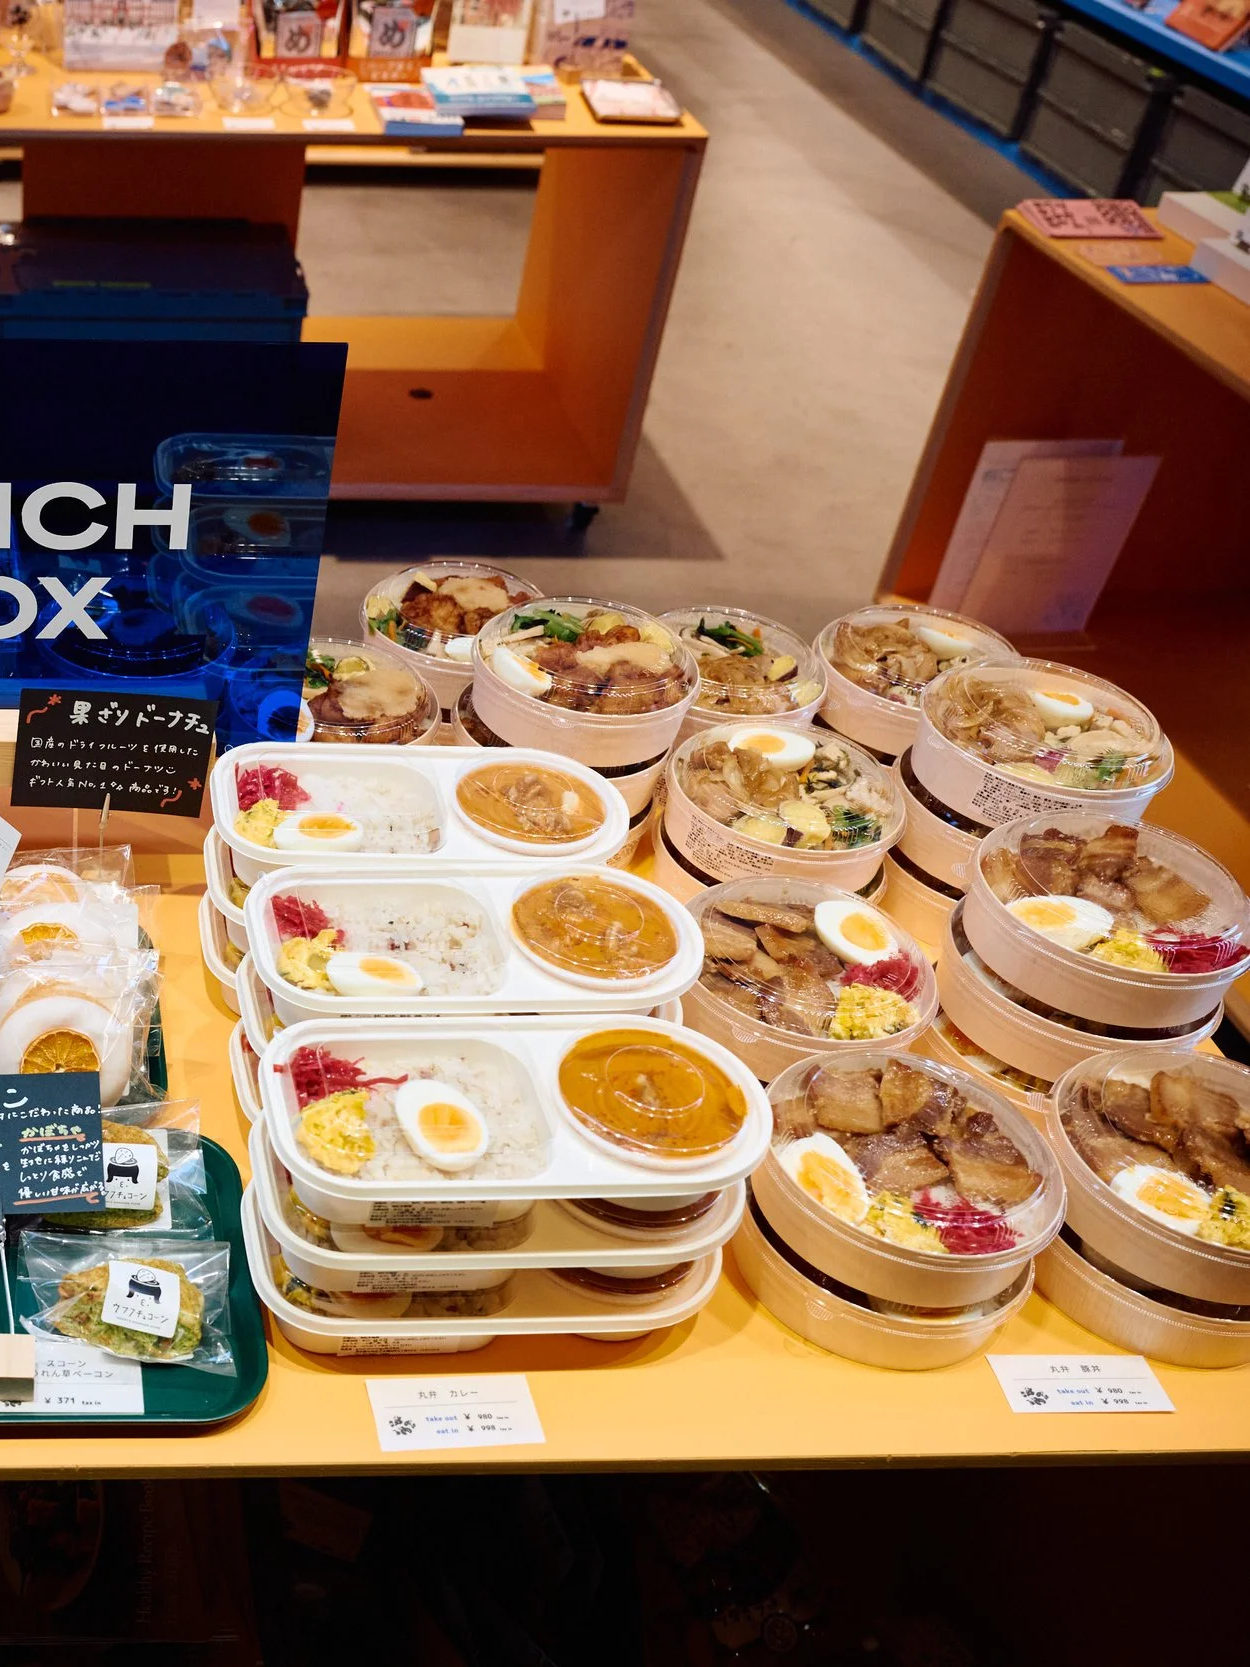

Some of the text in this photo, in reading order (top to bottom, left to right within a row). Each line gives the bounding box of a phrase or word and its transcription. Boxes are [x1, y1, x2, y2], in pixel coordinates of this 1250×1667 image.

[21, 1123, 82, 1138] かぼちゃ
[20, 1139, 100, 1155] かぼちゃをしっかり
[19, 1166, 88, 1183] しっとり食感で
[47, 1359, 87, 1368] スコーン
[449, 1389, 479, 1398] カレー
[57, 1396, 75, 1404] 371
